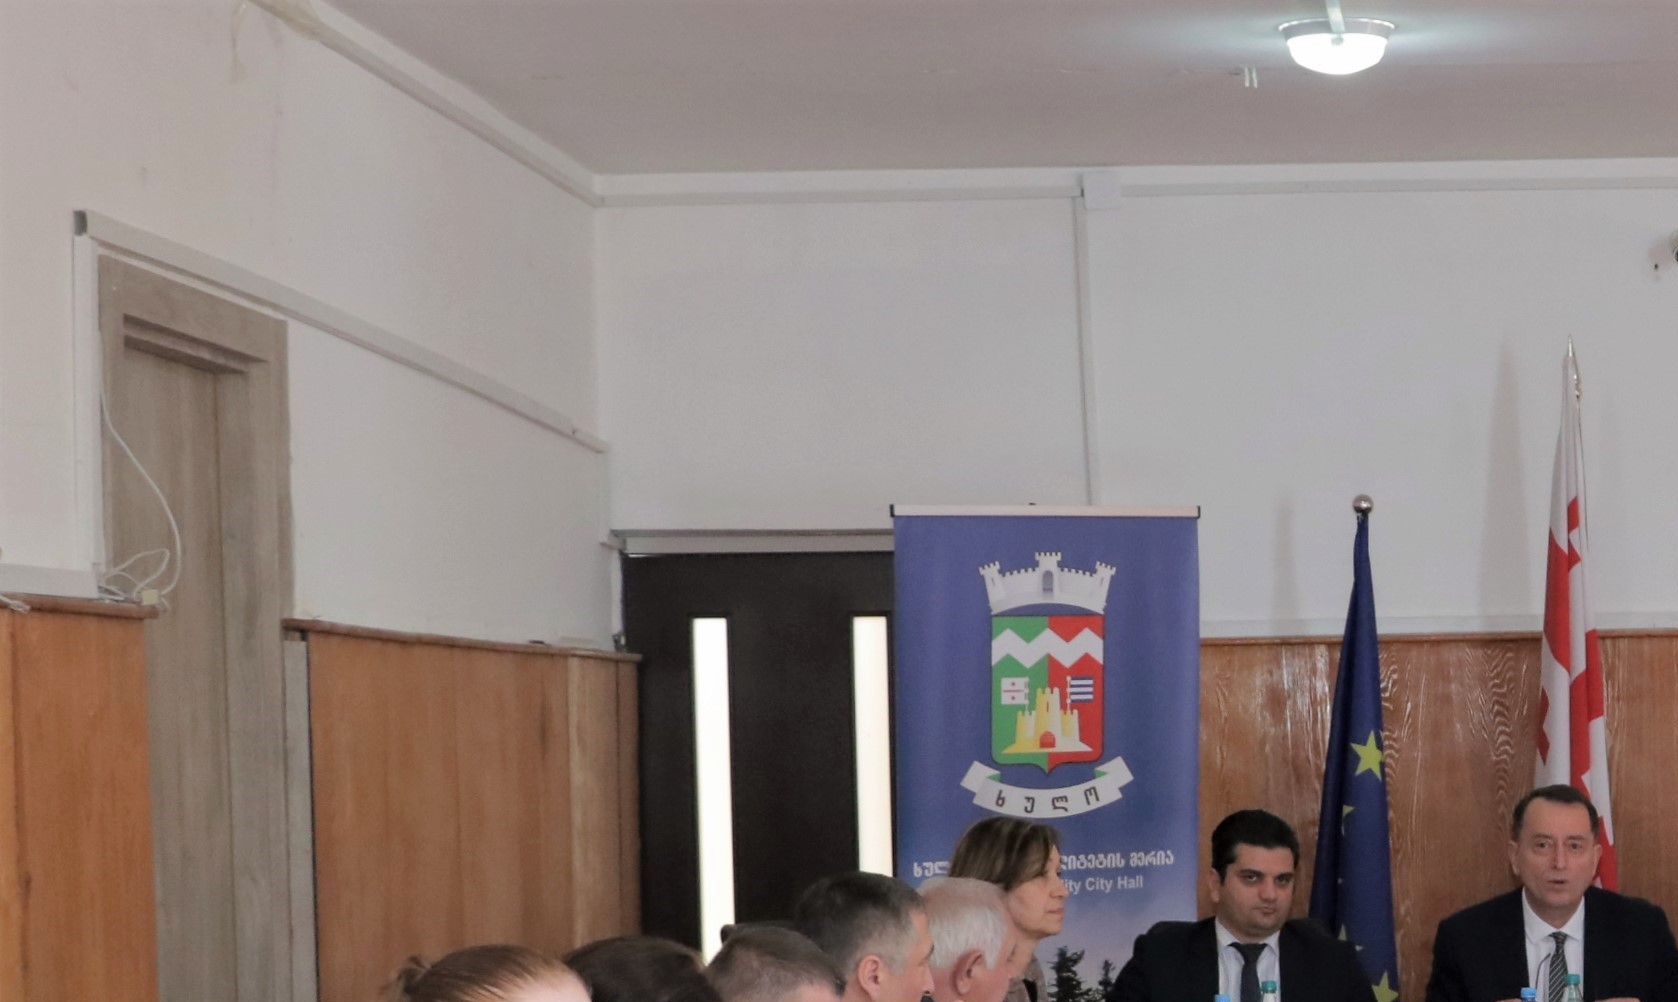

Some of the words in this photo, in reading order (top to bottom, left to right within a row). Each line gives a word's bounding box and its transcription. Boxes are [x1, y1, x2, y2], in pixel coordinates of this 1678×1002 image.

[995, 786, 1100, 814] ხულო
[1129, 849, 1175, 868] მერია
[1084, 876, 1113, 895] City
[1117, 875, 1144, 890] Hall
